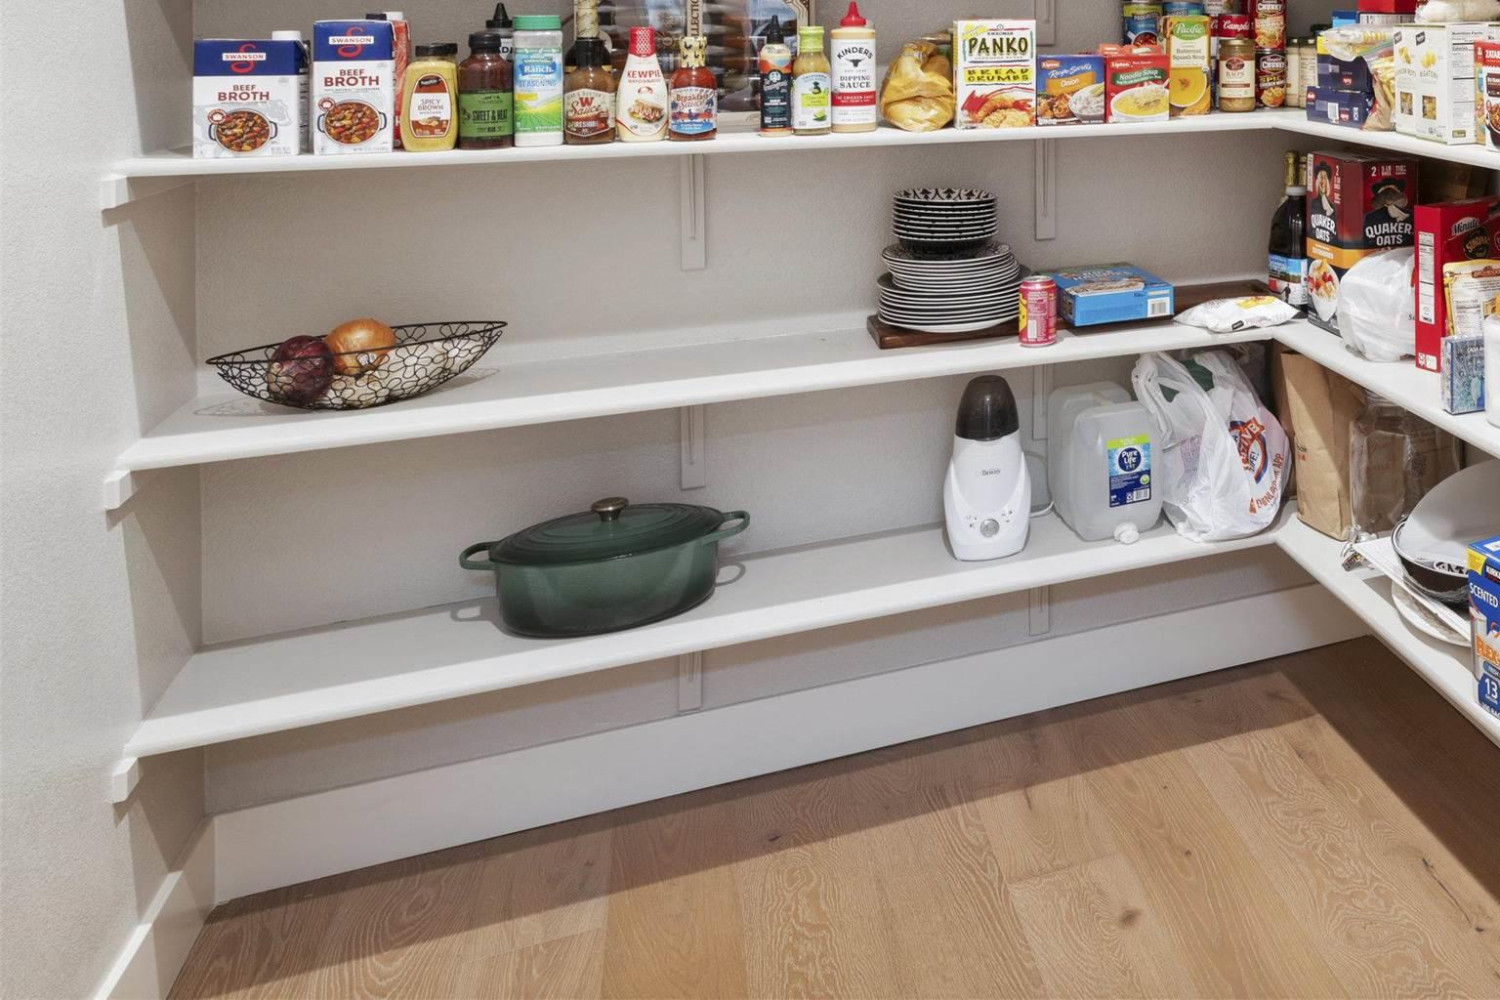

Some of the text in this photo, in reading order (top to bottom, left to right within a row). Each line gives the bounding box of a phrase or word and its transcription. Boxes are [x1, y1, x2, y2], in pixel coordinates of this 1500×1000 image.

[1175, 23, 1202, 34] Pacific
[968, 37, 1028, 54] PANKO
[324, 76, 379, 86] BROTH
[627, 70, 661, 78] KEWPIE
[218, 92, 269, 101] BROTH
[1371, 166, 1377, 176] 2
[1310, 214, 1336, 235] QUAKER
[1365, 222, 1413, 239] QUAKER
[1452, 218, 1479, 235] Minute
[1315, 227, 1330, 242] OATS
[1376, 234, 1403, 246] OATS
[1469, 582, 1498, 608] SCENTED
[1484, 679, 1498, 699] 13
